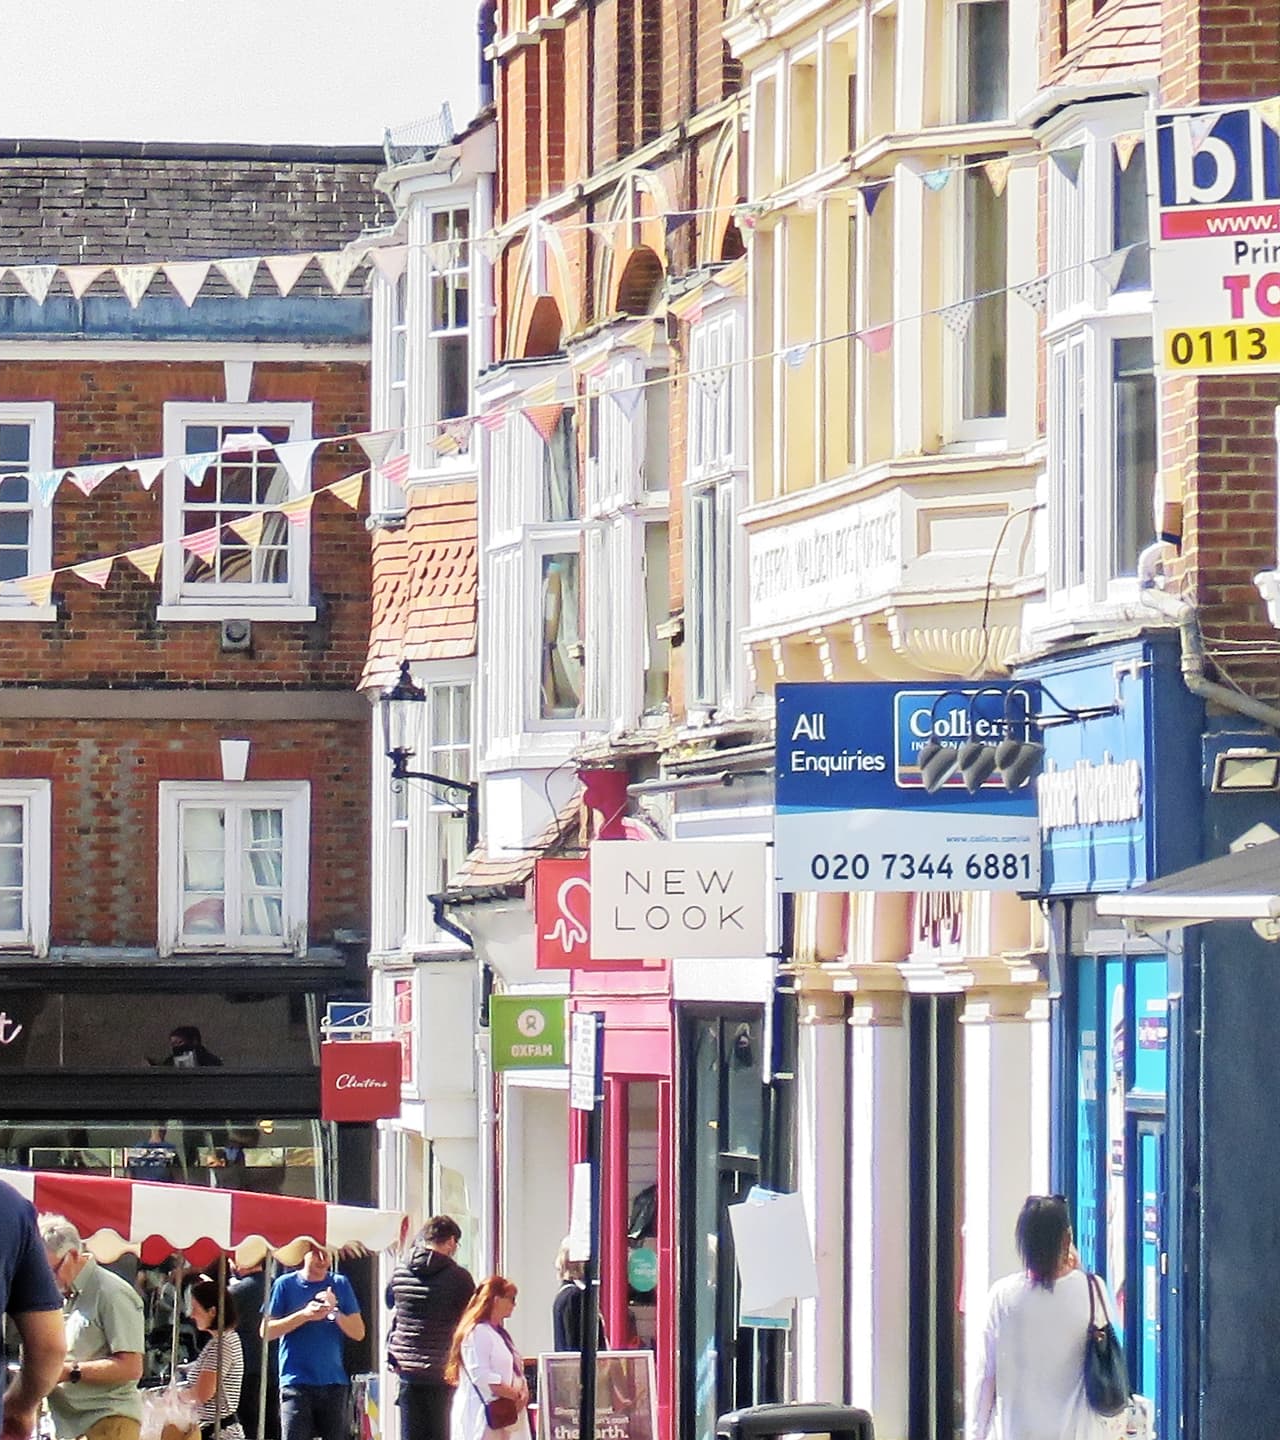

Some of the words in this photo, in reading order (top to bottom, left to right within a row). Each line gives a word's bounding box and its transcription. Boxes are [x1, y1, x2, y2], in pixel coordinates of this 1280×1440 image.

[1206, 211, 1280, 234] www.
[1171, 327, 1268, 365] 0113
[791, 714, 826, 741] All
[791, 749, 886, 777] Enquiries
[811, 853, 870, 881] 020
[881, 853, 954, 881] 7344
[965, 853, 1032, 881] 6881
[625, 870, 734, 895] NEW
[615, 905, 744, 930] LOOK
[511, 1044, 553, 1058] OXFAM
[336, 1073, 389, 1090] Clintons
[554, 1425, 580, 1439] the
[594, 1424, 630, 1439] arth.
